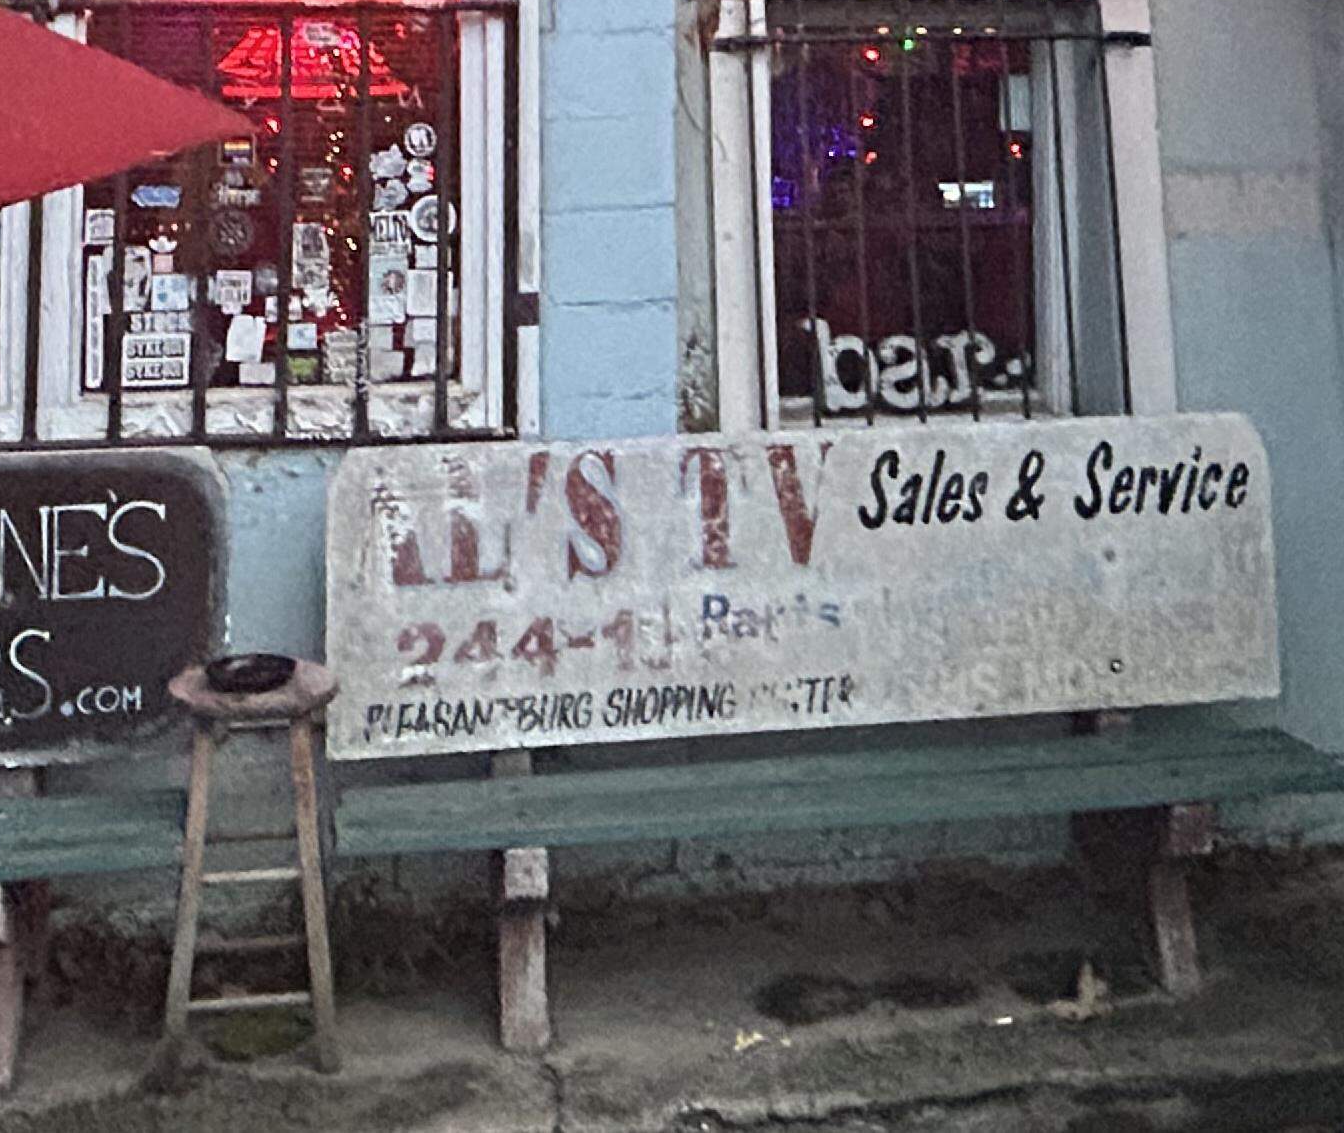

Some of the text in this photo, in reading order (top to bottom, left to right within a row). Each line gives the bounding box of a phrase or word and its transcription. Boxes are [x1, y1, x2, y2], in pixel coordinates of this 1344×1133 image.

[679, 443, 835, 569] TV
[858, 440, 1250, 529] Sales & Service
[602, 681, 737, 728] SHOPPING
